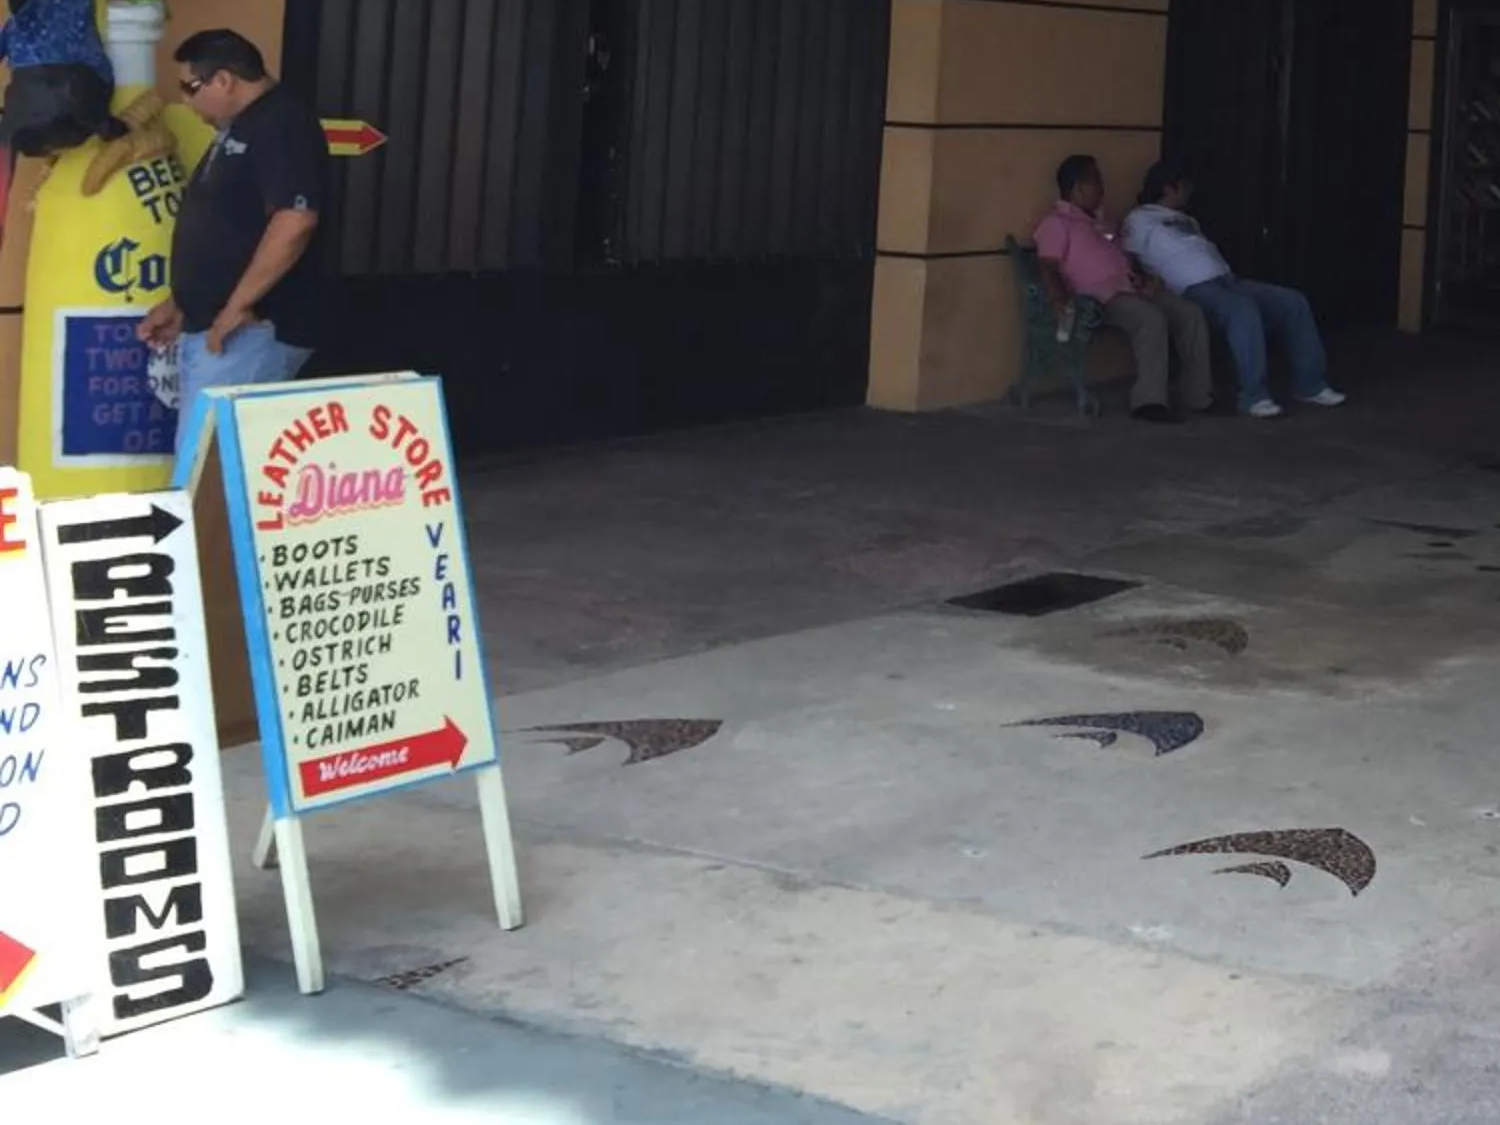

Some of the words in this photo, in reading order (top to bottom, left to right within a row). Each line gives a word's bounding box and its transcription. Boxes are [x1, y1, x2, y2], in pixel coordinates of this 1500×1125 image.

[85, 347, 142, 372] TWO
[88, 376, 141, 396] FOR
[92, 401, 143, 425] GET
[256, 401, 350, 531] LEATHER
[369, 404, 451, 508] STORE
[287, 462, 406, 520] Diana
[272, 535, 359, 567] BOOTS
[273, 556, 391, 592] WALLETS
[285, 604, 405, 644] CROCODILE
[292, 633, 392, 671] OSTRICH
[296, 663, 369, 697] BELTS
[301, 678, 420, 723] ALLIGATOR
[306, 710, 396, 748] CAIMAN
[318, 745, 409, 781] Welcome
[71, 553, 214, 1020] RESTROOMS
